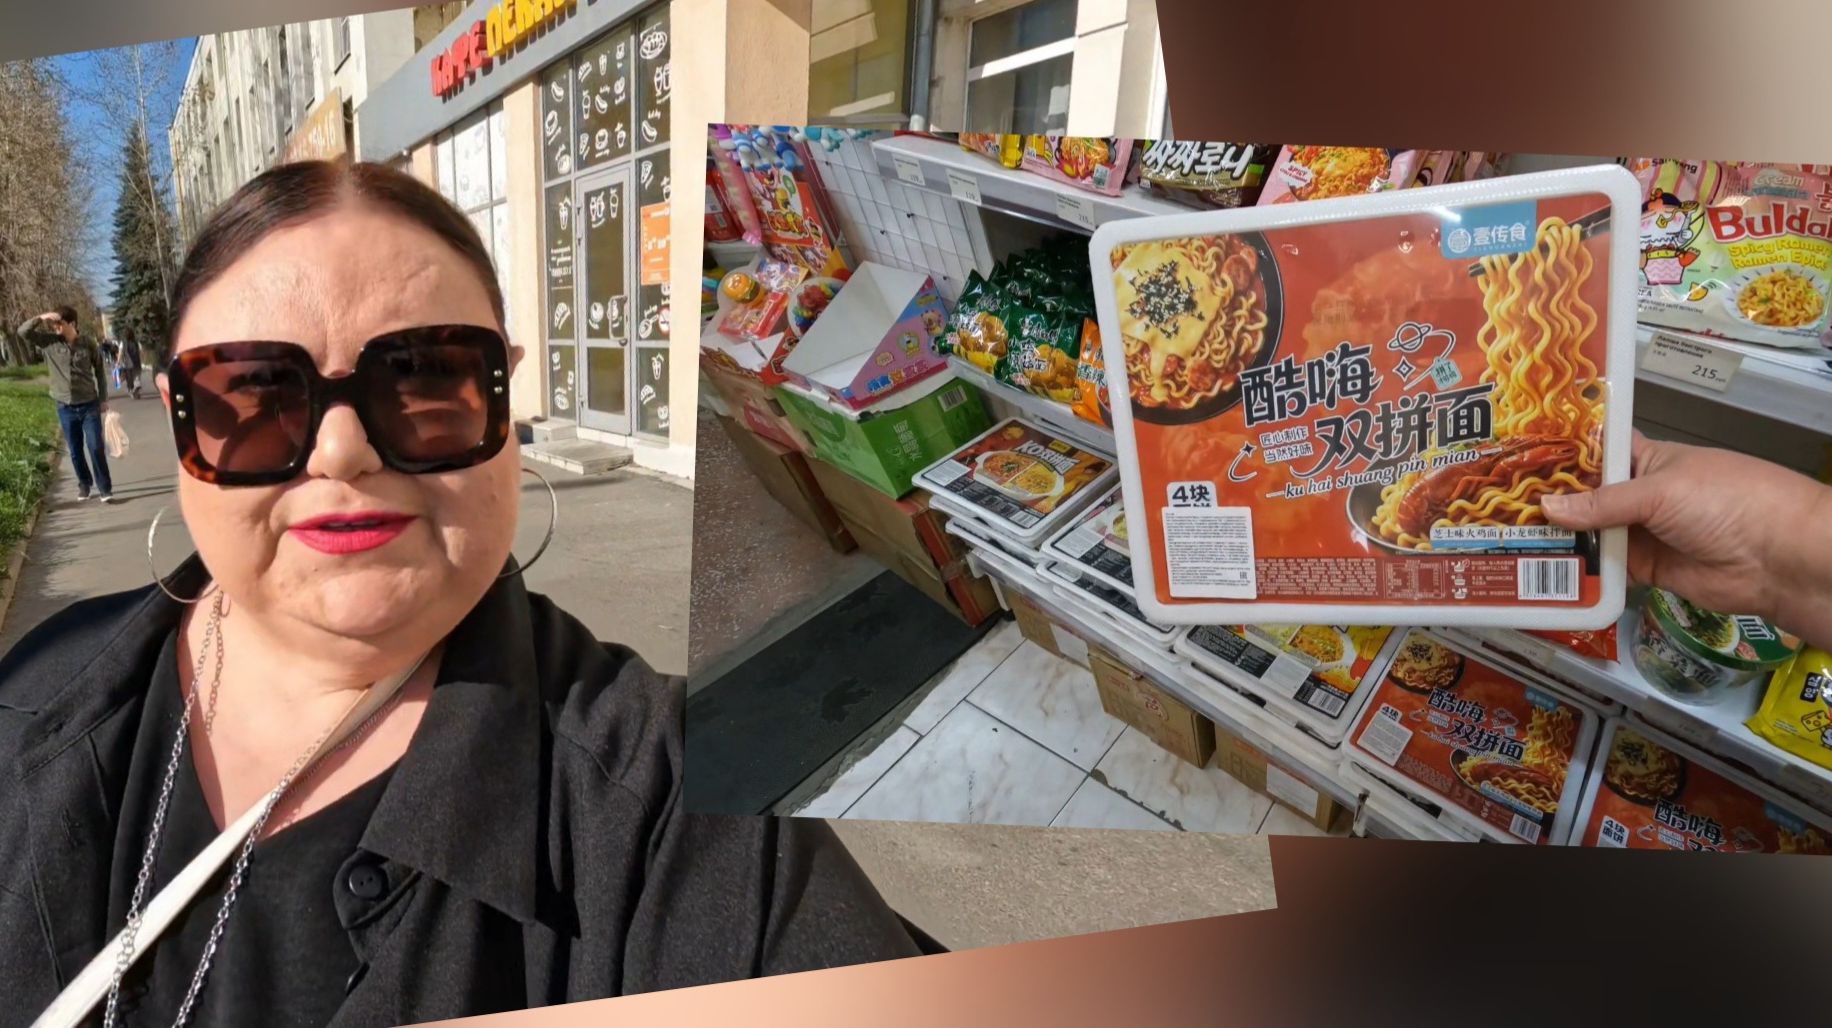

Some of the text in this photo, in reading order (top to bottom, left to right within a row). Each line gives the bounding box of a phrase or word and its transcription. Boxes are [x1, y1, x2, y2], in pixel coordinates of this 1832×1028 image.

[431, 0, 566, 97] КАФЕ ПЕКА
[1142, 140, 1254, 178] 짜짜로니
[1754, 174, 1803, 187] Cream
[1707, 203, 1832, 241] Bulda
[1238, 341, 1383, 427] 酷嗨
[1692, 364, 1718, 379] 215
[1260, 427, 1308, 446] 匠心制作
[1291, 383, 1494, 478] 双拼面
[1264, 443, 1312, 462] 当然好味
[1285, 449, 1479, 499] ku hai shuang pin mian
[1172, 484, 1211, 503] 4块
[1434, 528, 1497, 539] 芝士味火鸡面
[1428, 688, 1487, 723] 酷嗨
[1436, 718, 1526, 761] 双拼面
[1654, 801, 1726, 846] 酷嗨
